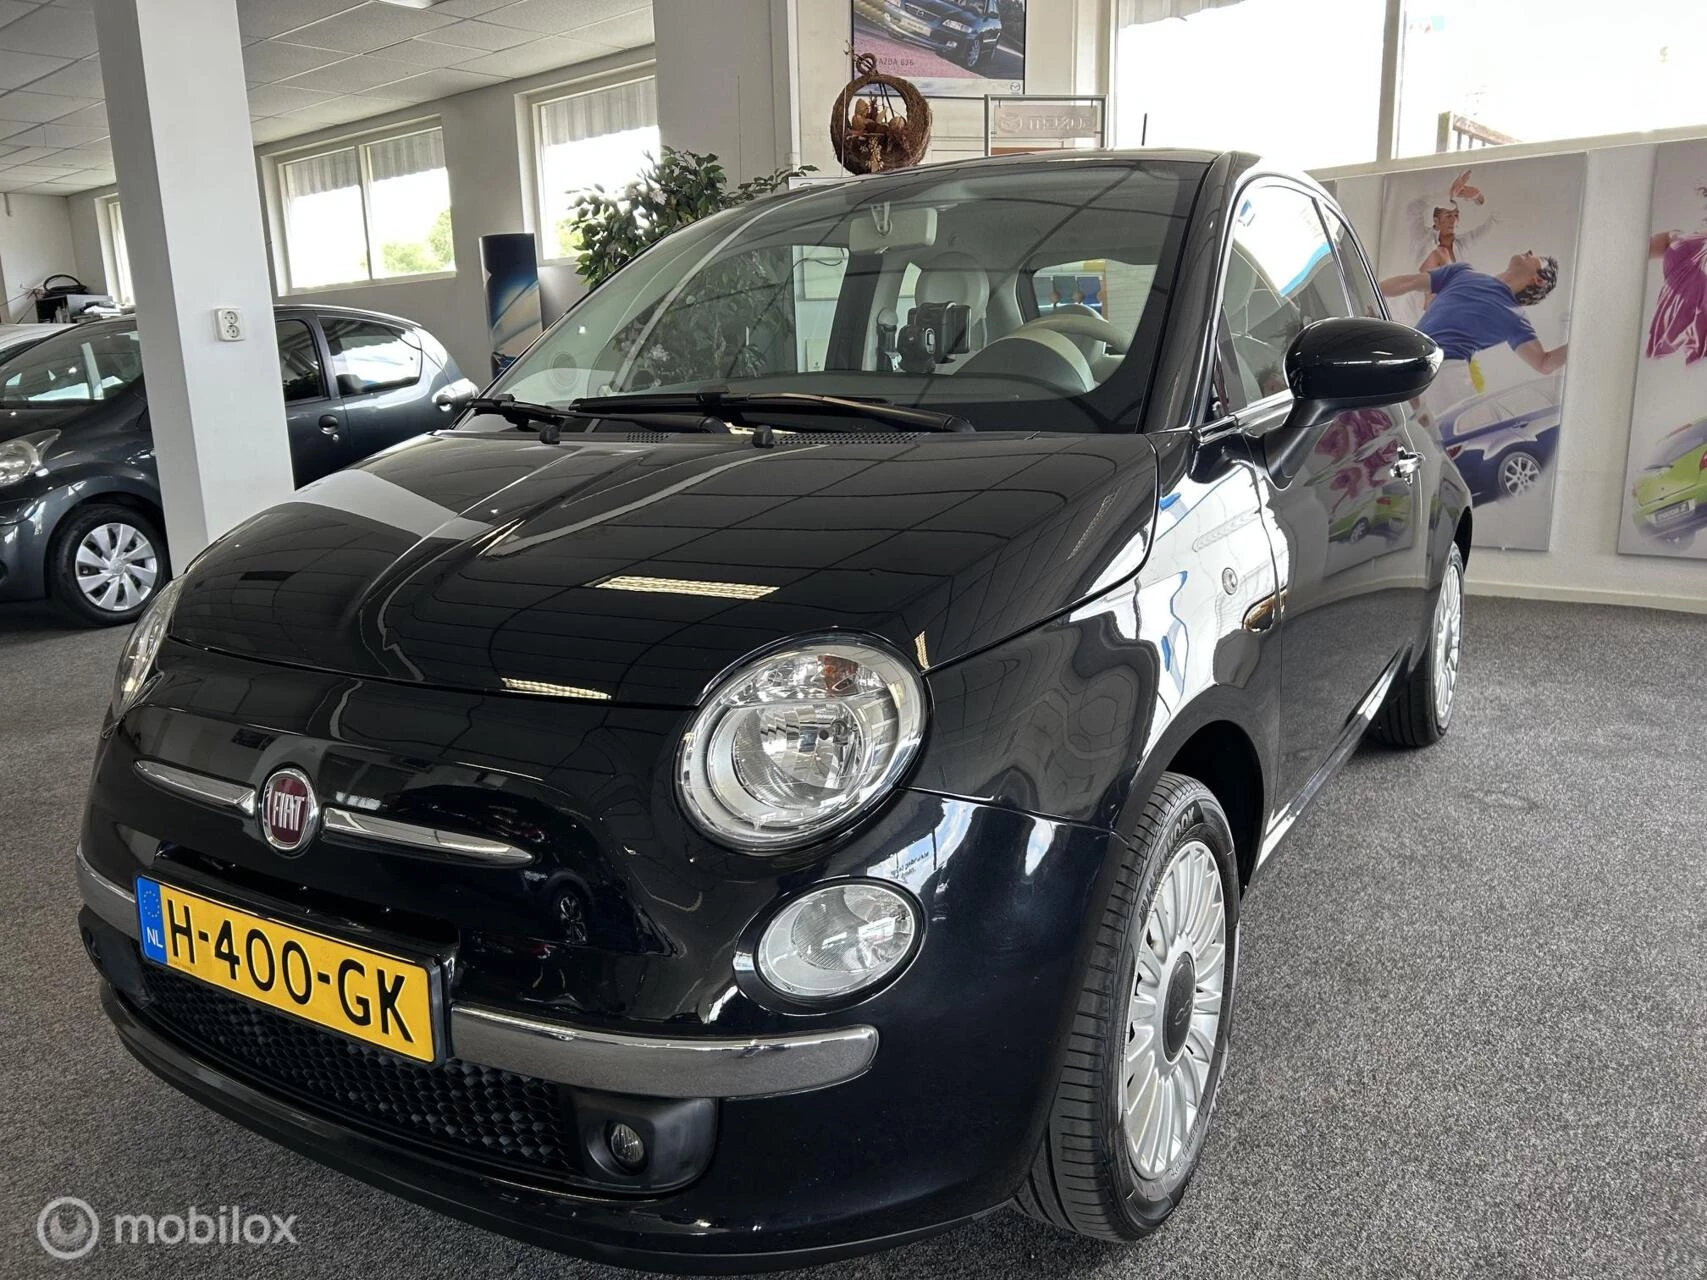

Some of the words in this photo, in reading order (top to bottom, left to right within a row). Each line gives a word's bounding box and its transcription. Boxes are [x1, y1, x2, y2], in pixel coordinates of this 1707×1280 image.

[878, 57, 899, 67] AZDA
[271, 791, 305, 832] FIAT
[146, 926, 163, 949] NL
[167, 899, 415, 1043] H-400-GK
